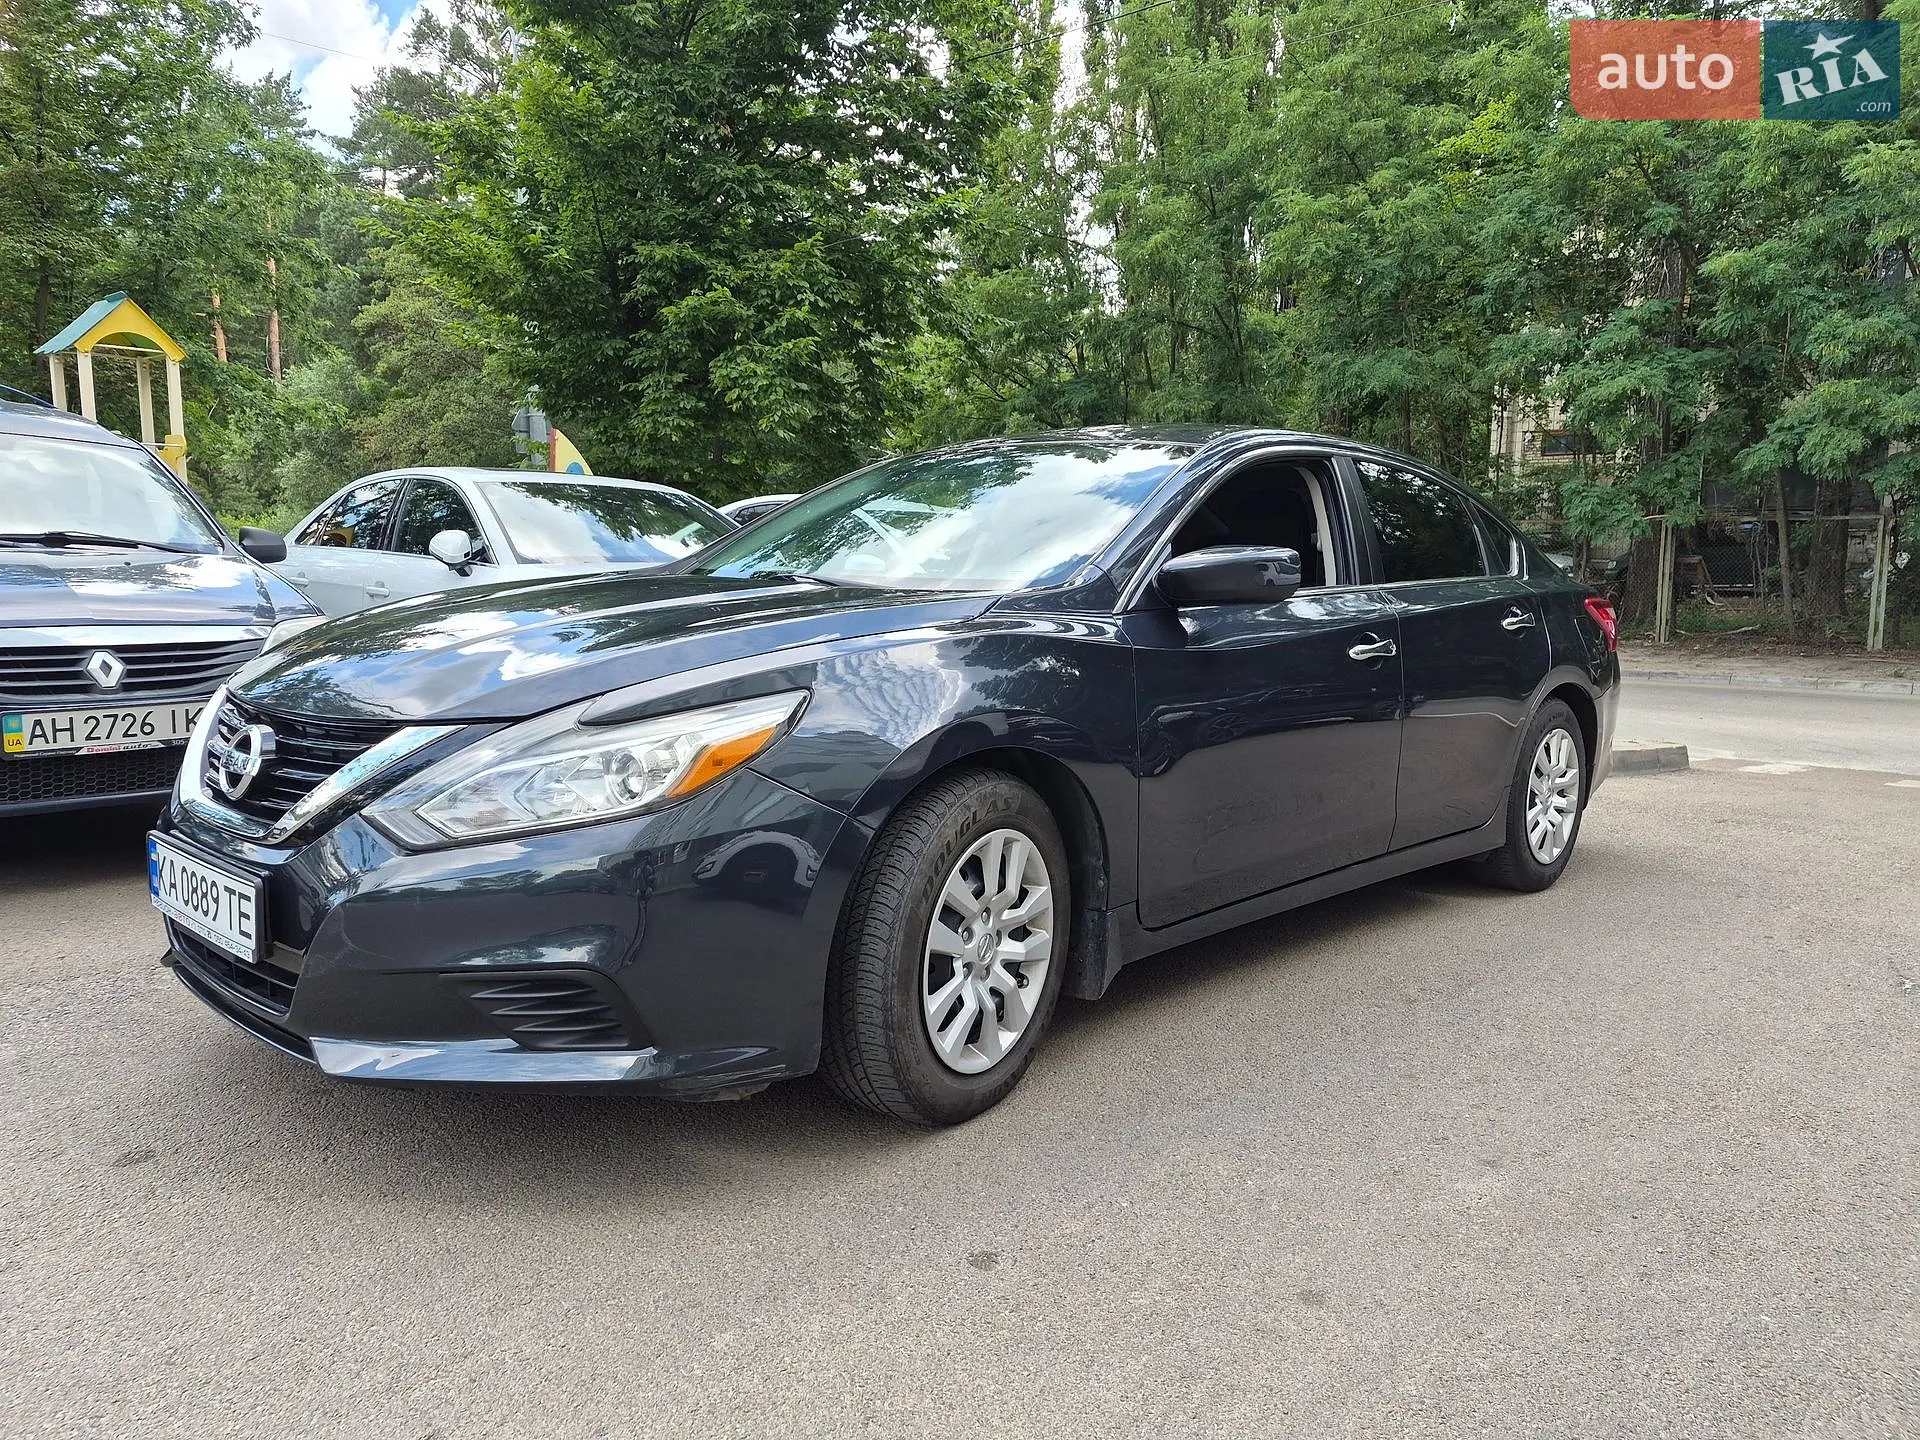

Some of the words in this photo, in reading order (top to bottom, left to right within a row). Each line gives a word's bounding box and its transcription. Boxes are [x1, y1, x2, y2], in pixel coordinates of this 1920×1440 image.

[7, 739, 23, 747] UA
[28, 717, 75, 745] AH
[83, 711, 155, 741] 2726
[170, 707, 204, 734] IK
[922, 797, 1012, 904] DOUGLAS
[158, 852, 178, 902] KA
[181, 866, 219, 922] 0889
[223, 884, 252, 940] TE
